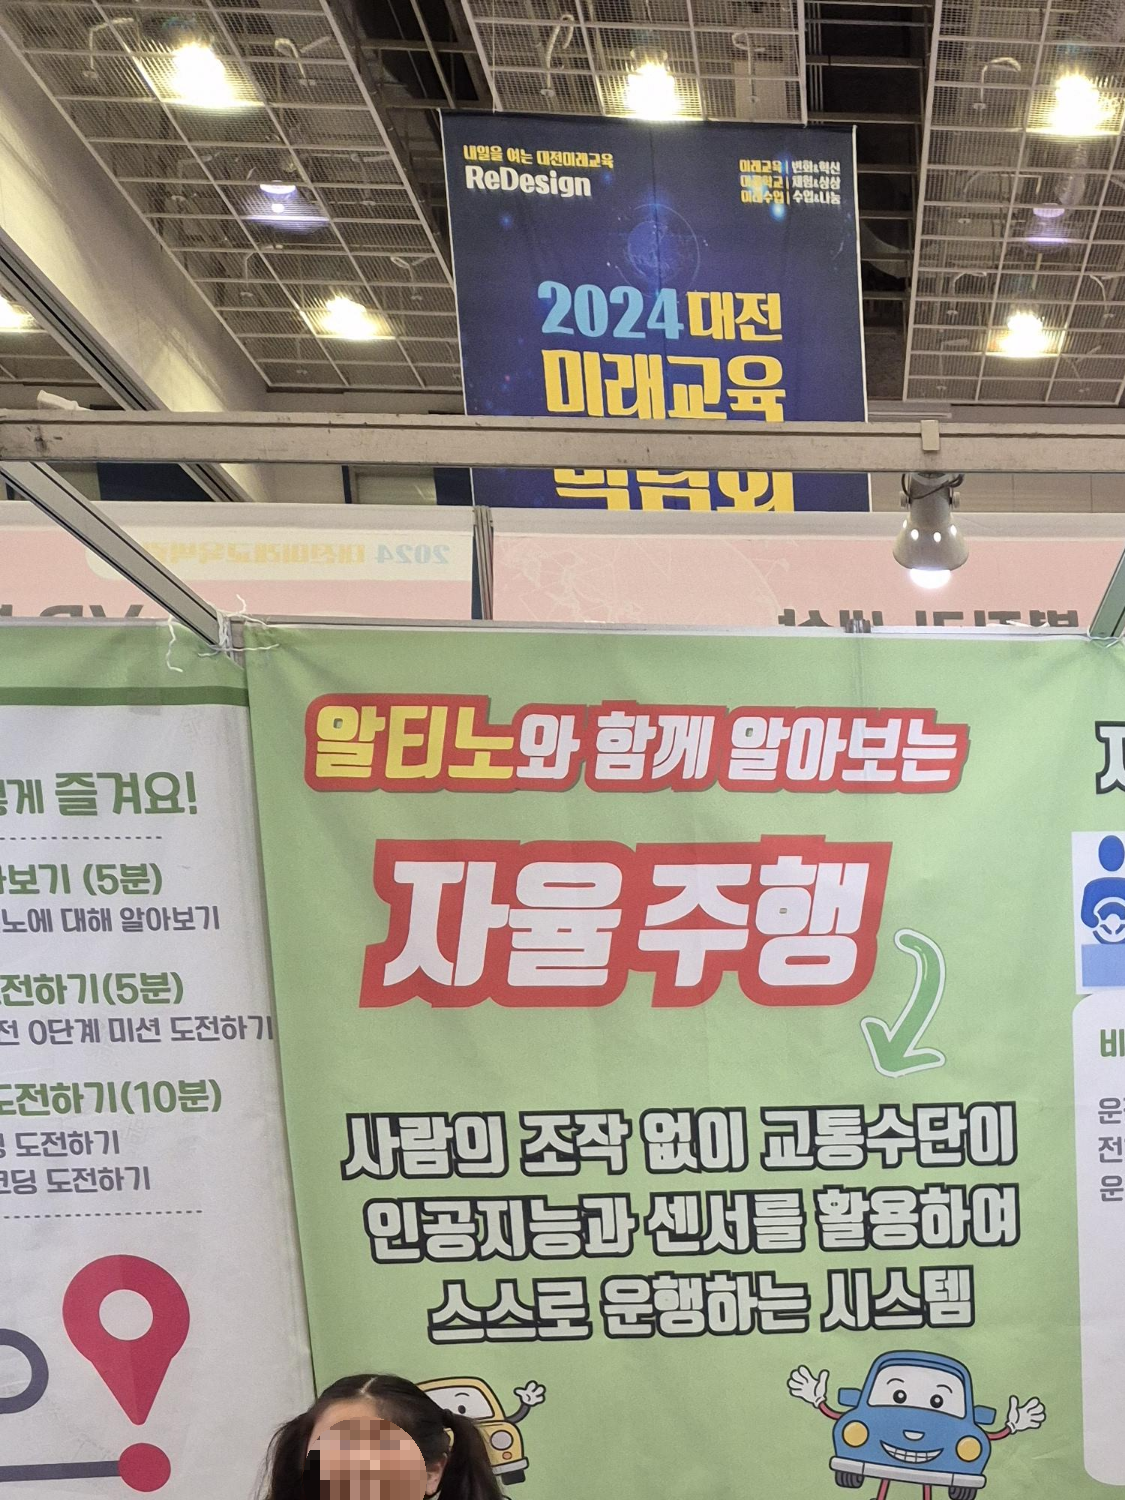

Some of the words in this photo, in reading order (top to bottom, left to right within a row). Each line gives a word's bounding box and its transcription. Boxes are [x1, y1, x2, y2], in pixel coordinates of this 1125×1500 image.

[463, 144, 503, 161] 내일을
[507, 148, 533, 164] 여는
[536, 150, 614, 169] 대전미래교육
[465, 165, 592, 198] ReDesign
[537, 280, 684, 339] 2024
[686, 289, 783, 341] 대전
[541, 349, 787, 422] 미래교육
[315, 705, 580, 781] 알티노와
[594, 710, 714, 781] 함께
[728, 716, 958, 782] 알아보는
[55, 770, 198, 817] 즐겨요!
[83, 863, 163, 896] (5분)
[61, 907, 113, 932] 대해
[120, 906, 220, 933] 알아보기
[28, 1018, 100, 1045] 0단계
[108, 1016, 161, 1043] 미션
[170, 1015, 274, 1042] 도전하기
[15, 1130, 120, 1158] 도전하기
[343, 1113, 506, 1180] 사람의
[520, 1110, 631, 1175] 조작
[639, 1107, 747, 1173] 없이
[760, 1102, 1017, 1171] 교통수단이
[46, 1166, 151, 1193] 도전하기
[364, 1194, 637, 1264] 인공지능과
[647, 1188, 803, 1257] 센서를
[816, 1183, 1020, 1252] 활용하여
[428, 1278, 592, 1344] 스스로
[602, 1271, 809, 1339] 운행하는
[820, 1265, 976, 1332] 시스템
